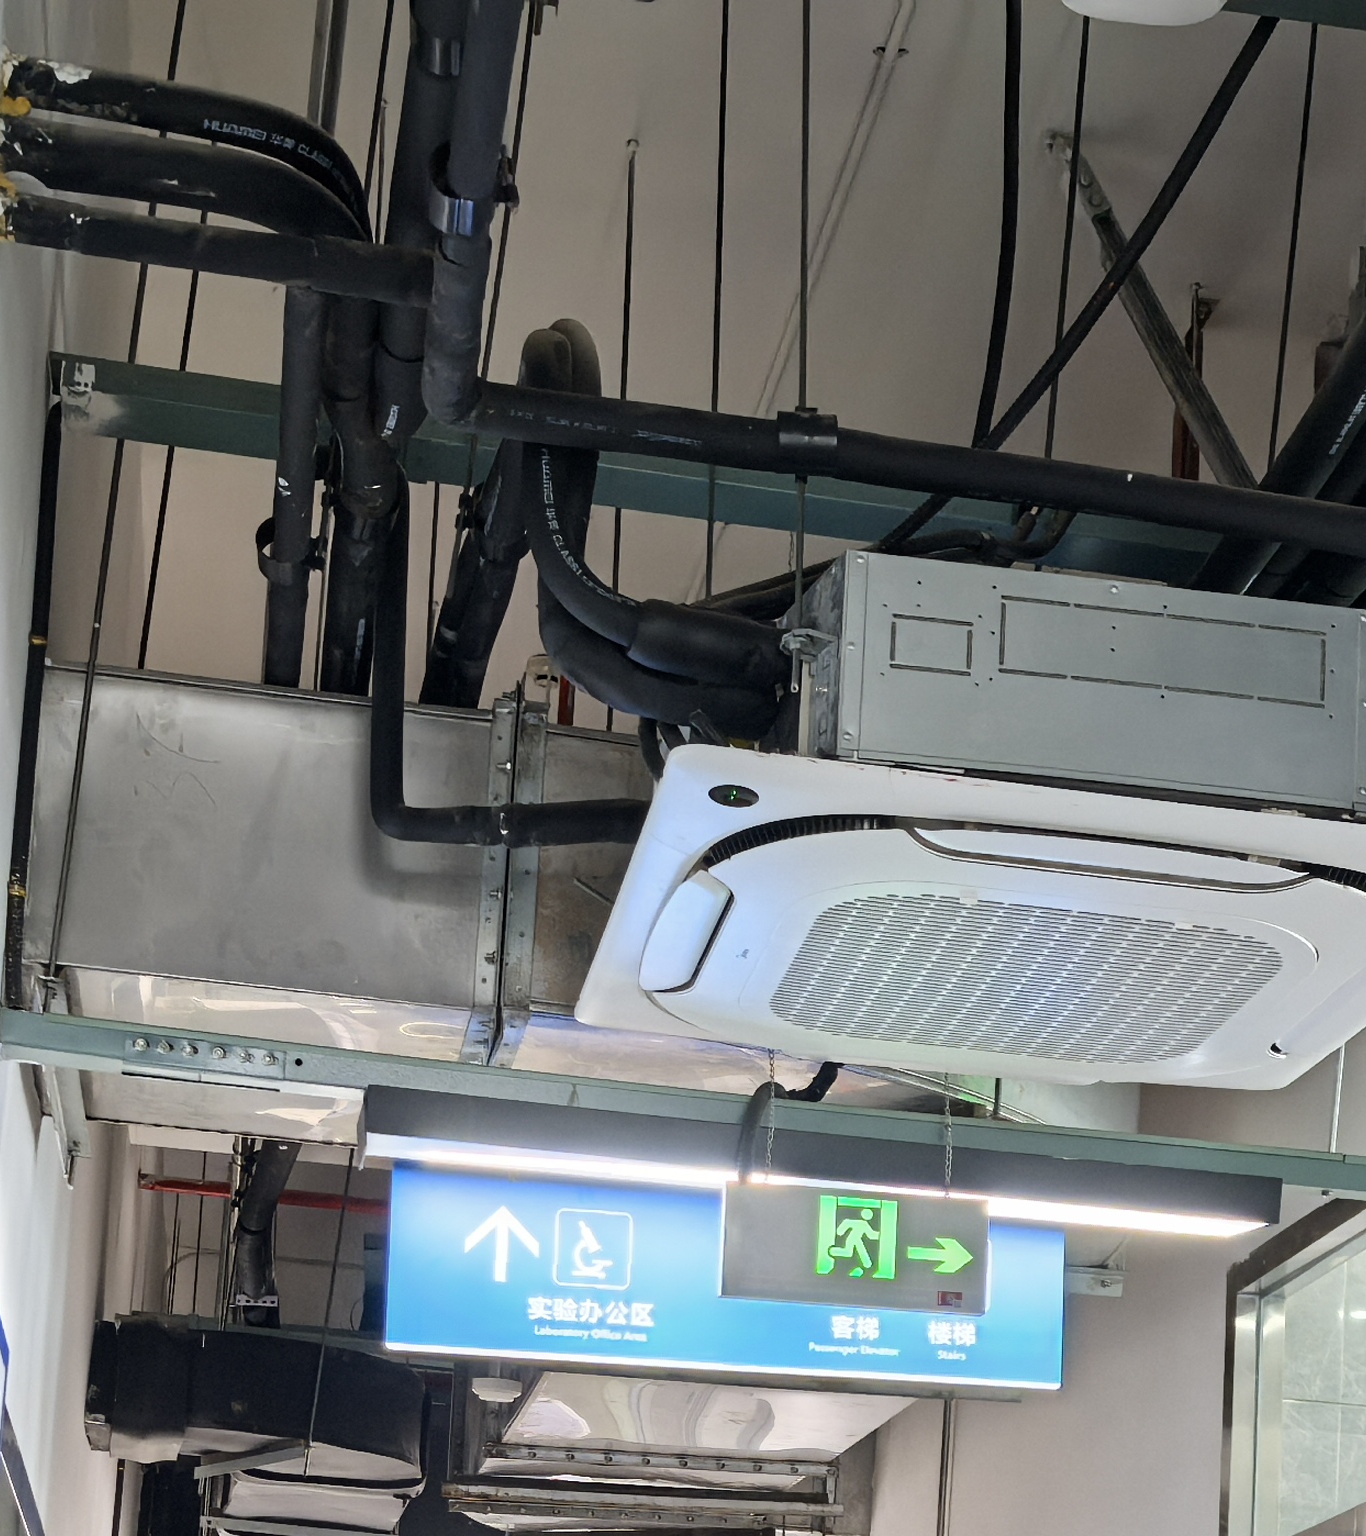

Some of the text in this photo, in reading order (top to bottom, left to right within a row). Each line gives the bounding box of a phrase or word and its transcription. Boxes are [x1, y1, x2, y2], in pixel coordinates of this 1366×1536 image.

[527, 1296, 655, 1328] 实验办公区
[830, 1314, 881, 1341] 客梯
[927, 1320, 977, 1347] 楼梯
[937, 1349, 967, 1362] Stairs
